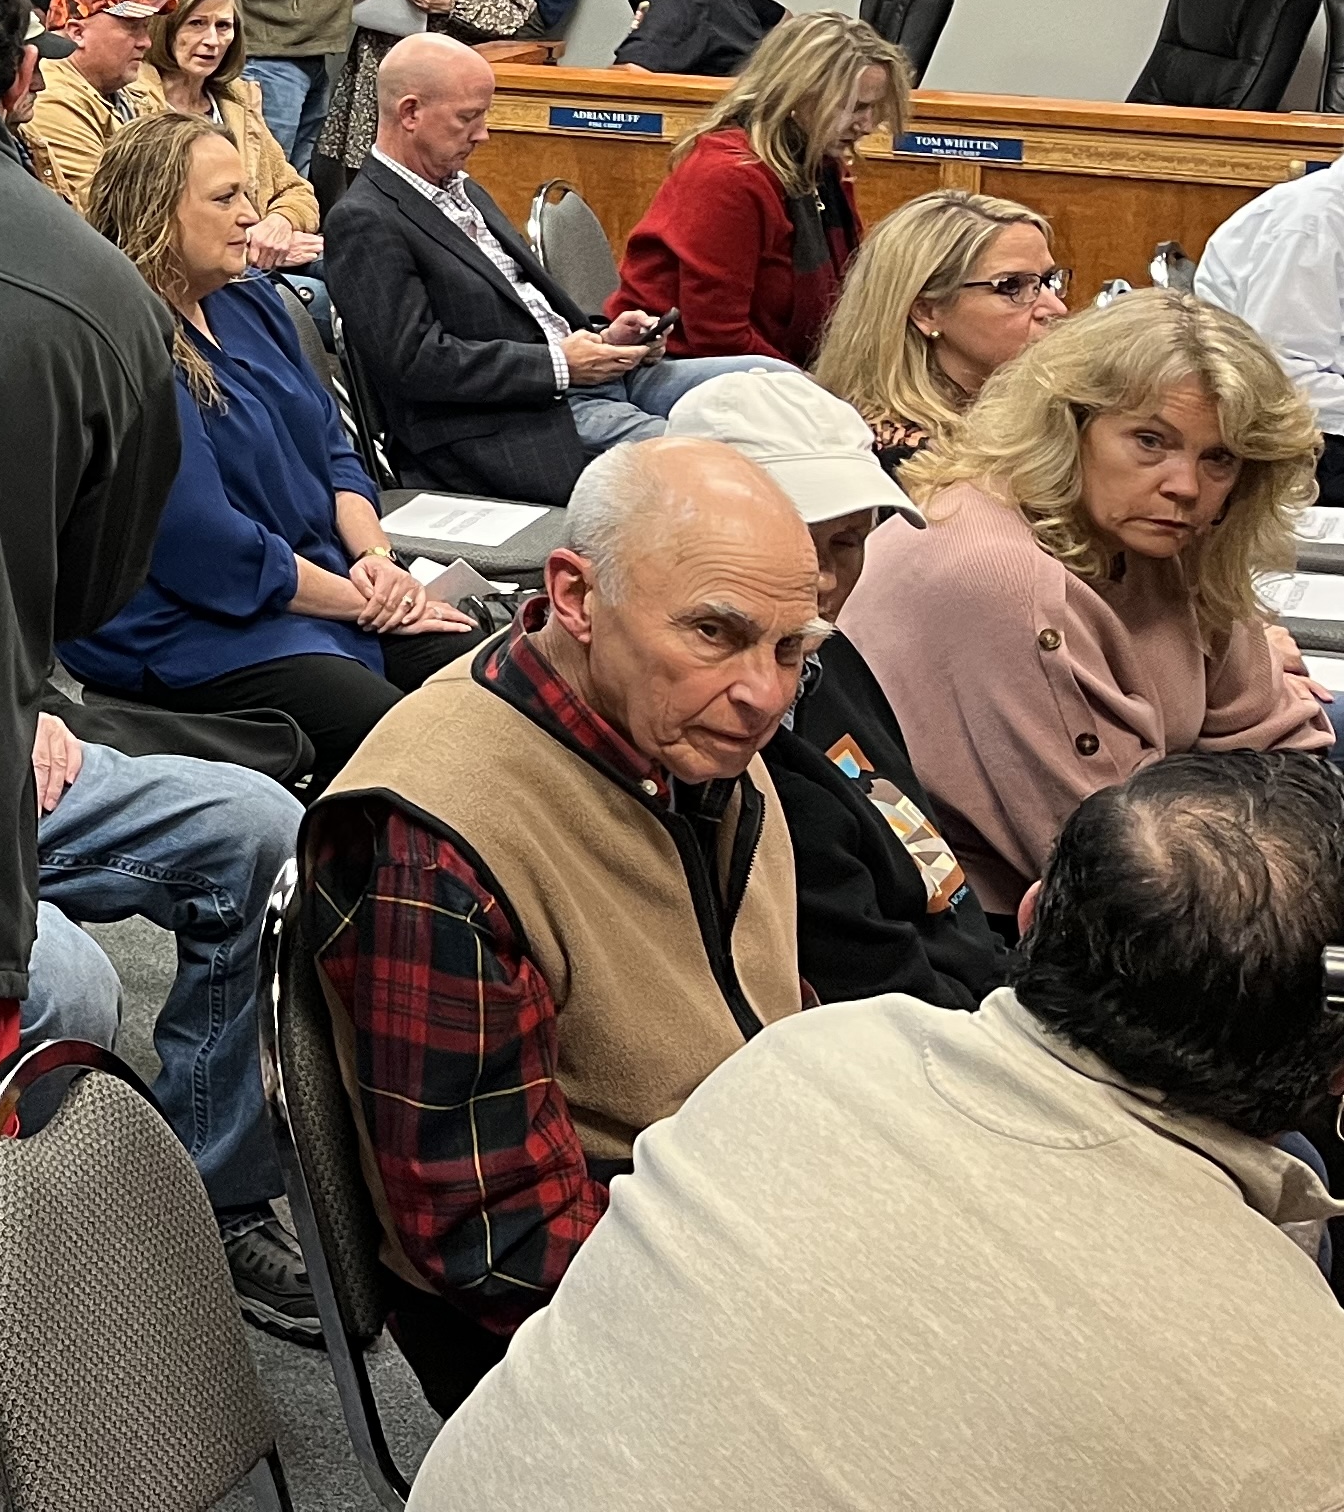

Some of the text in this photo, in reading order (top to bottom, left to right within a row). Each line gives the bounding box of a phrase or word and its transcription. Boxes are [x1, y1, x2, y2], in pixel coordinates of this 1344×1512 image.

[572, 110, 641, 123] ADRIAN HUFF
[914, 136, 1000, 151] TOM WHITTEN
